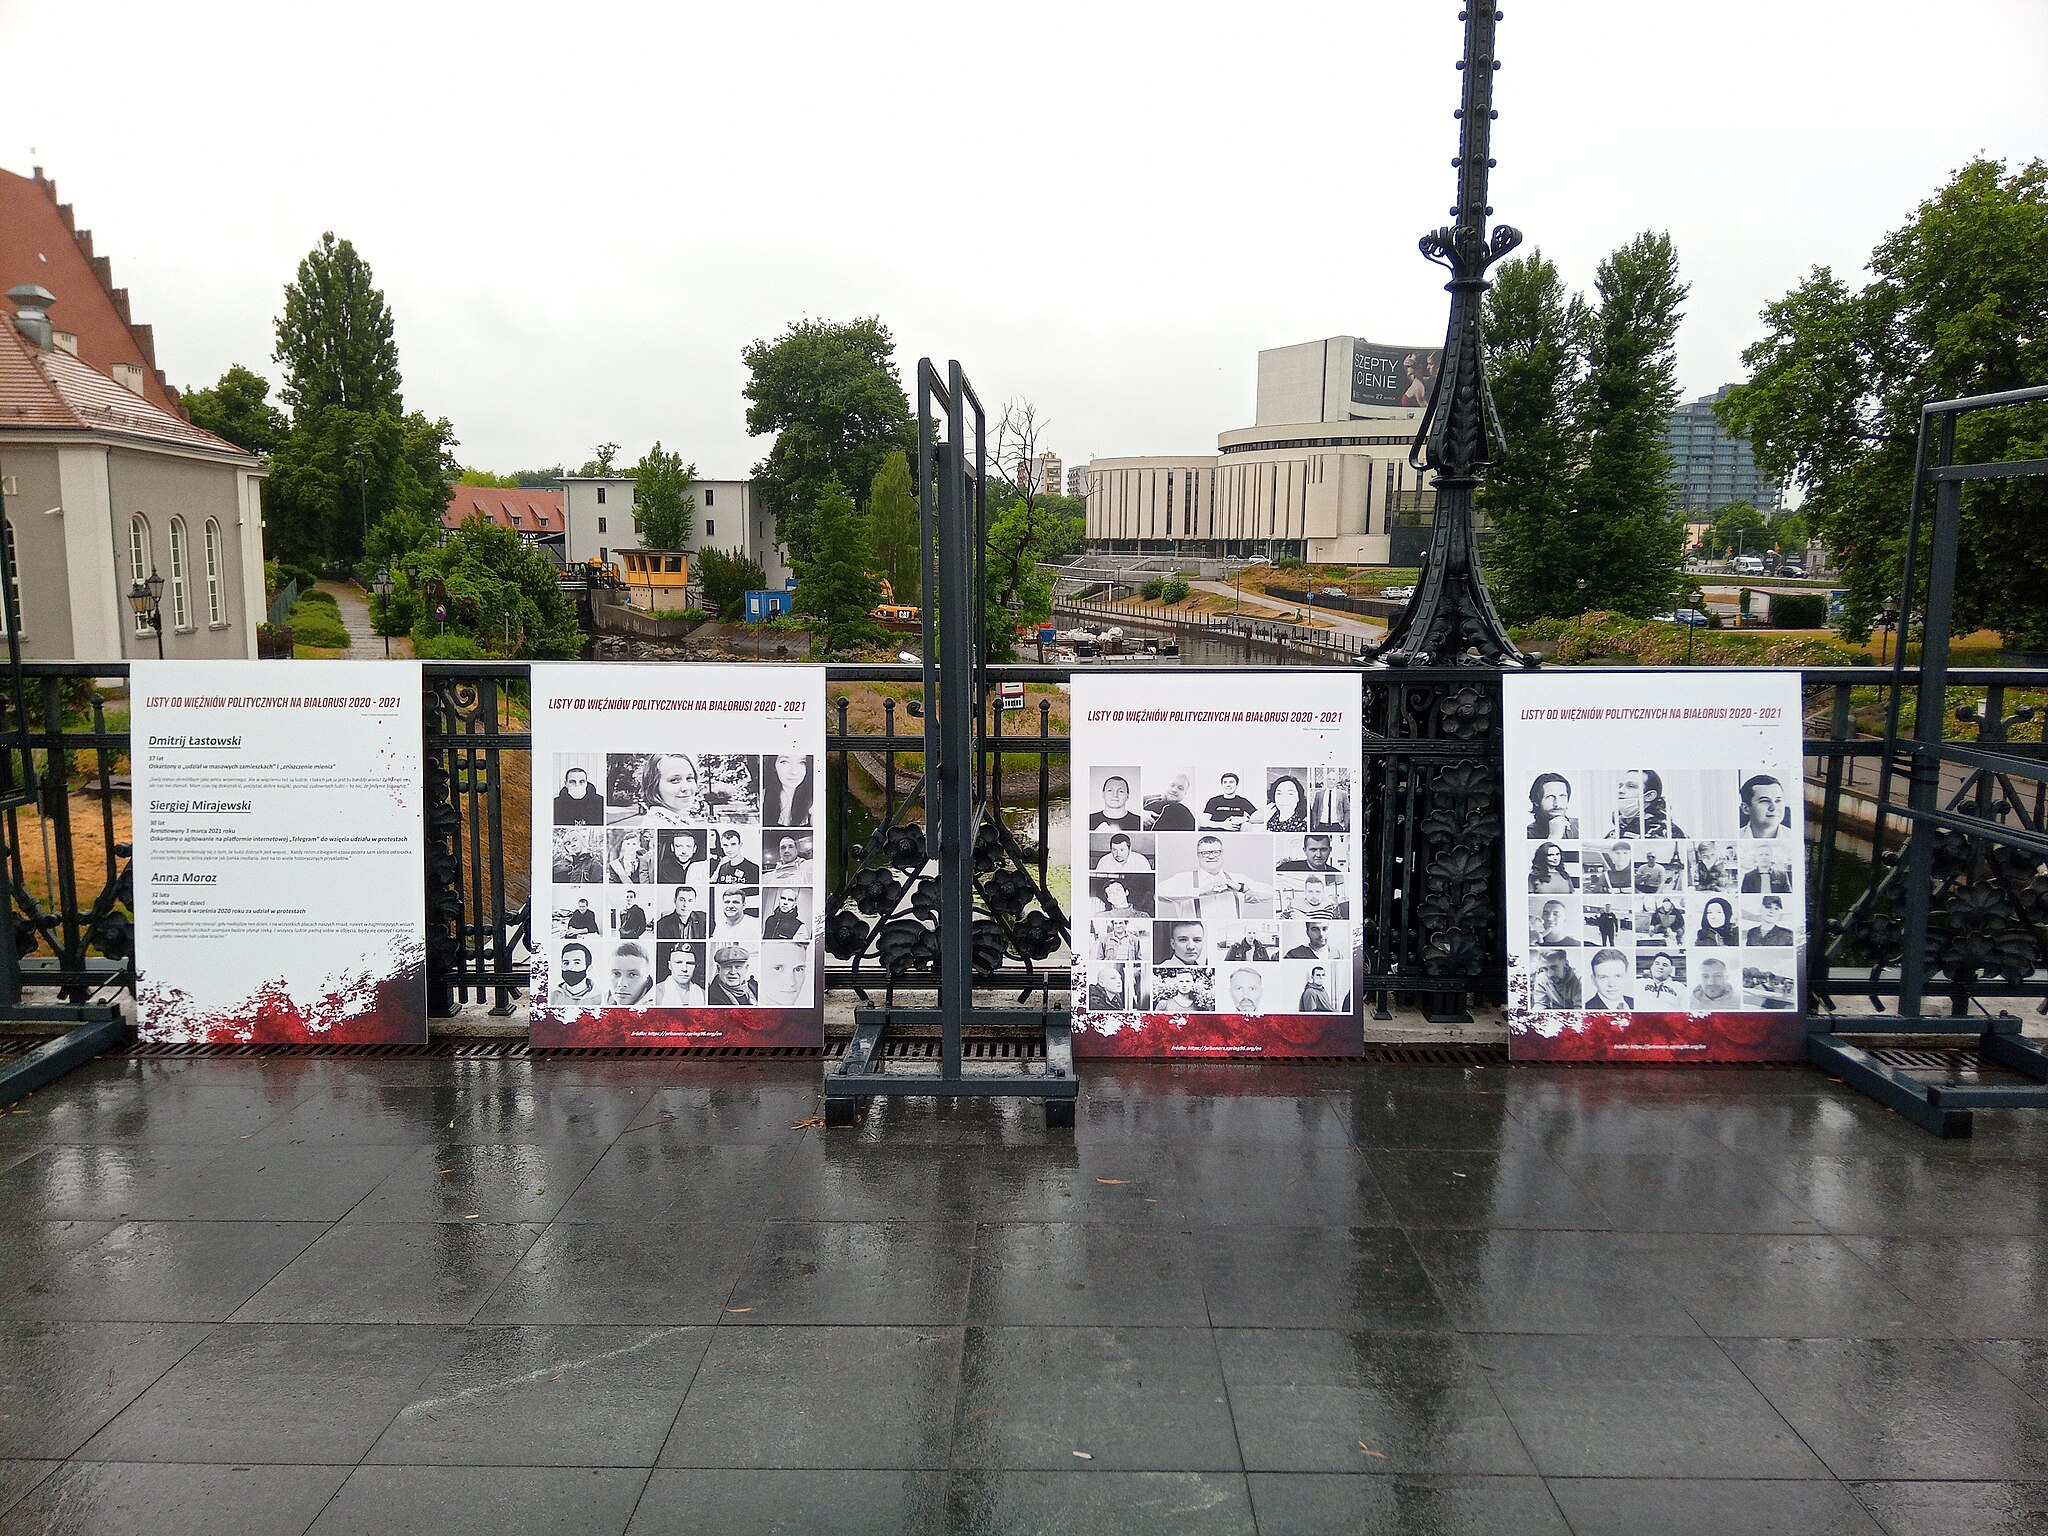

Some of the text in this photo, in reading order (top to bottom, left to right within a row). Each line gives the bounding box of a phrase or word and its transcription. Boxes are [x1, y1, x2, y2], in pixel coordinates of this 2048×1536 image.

[1354, 354, 1398, 373] SZEPTY
[1357, 371, 1397, 389] CIENIE
[899, 611, 910, 619] CAT
[146, 697, 170, 708] LISTY
[171, 697, 182, 708] OD
[184, 695, 227, 710] WIĘŹNIÓW
[228, 697, 288, 708] POLITYCZNYCH
[290, 697, 302, 708] NA
[304, 697, 347, 708] BIAŁORUSI
[349, 697, 371, 708] 2020
[378, 697, 401, 708] 2021
[548, 699, 573, 710] LISTY
[574, 699, 586, 710] OD
[588, 697, 631, 712] WIĘŹNIÓW
[632, 699, 694, 711] POLITYCZNYCH
[695, 700, 707, 711] NA
[709, 700, 753, 711] BIAŁORUSI
[754, 701, 776, 712] 2020
[784, 701, 806, 712] 2021
[1088, 711, 1112, 722] LISTY
[1112, 711, 1124, 722] OD
[1126, 709, 1168, 724] WIĘŹNIÓW
[1169, 711, 1230, 722] POLITYCZNYCH
[1232, 712, 1243, 722] NA
[1246, 712, 1289, 723] BIAŁORUSI
[1290, 712, 1313, 723] 2020
[1320, 712, 1342, 723] 2021
[1521, 710, 1545, 720] LISTY
[1546, 710, 1558, 720] OD
[1560, 707, 1604, 722] WIĘŹNIÓW
[1605, 708, 1668, 720] POLITYCZNYCH
[1669, 708, 1680, 719] NA
[1683, 708, 1728, 719] BIAŁORUSI
[1729, 708, 1752, 719] 2020
[1760, 708, 1782, 719] 2021
[148, 735, 242, 749] Dmitrij Łastowski
[150, 800, 252, 813] Siergiej Mirajewski
[151, 873, 217, 882] Anna Moroz
